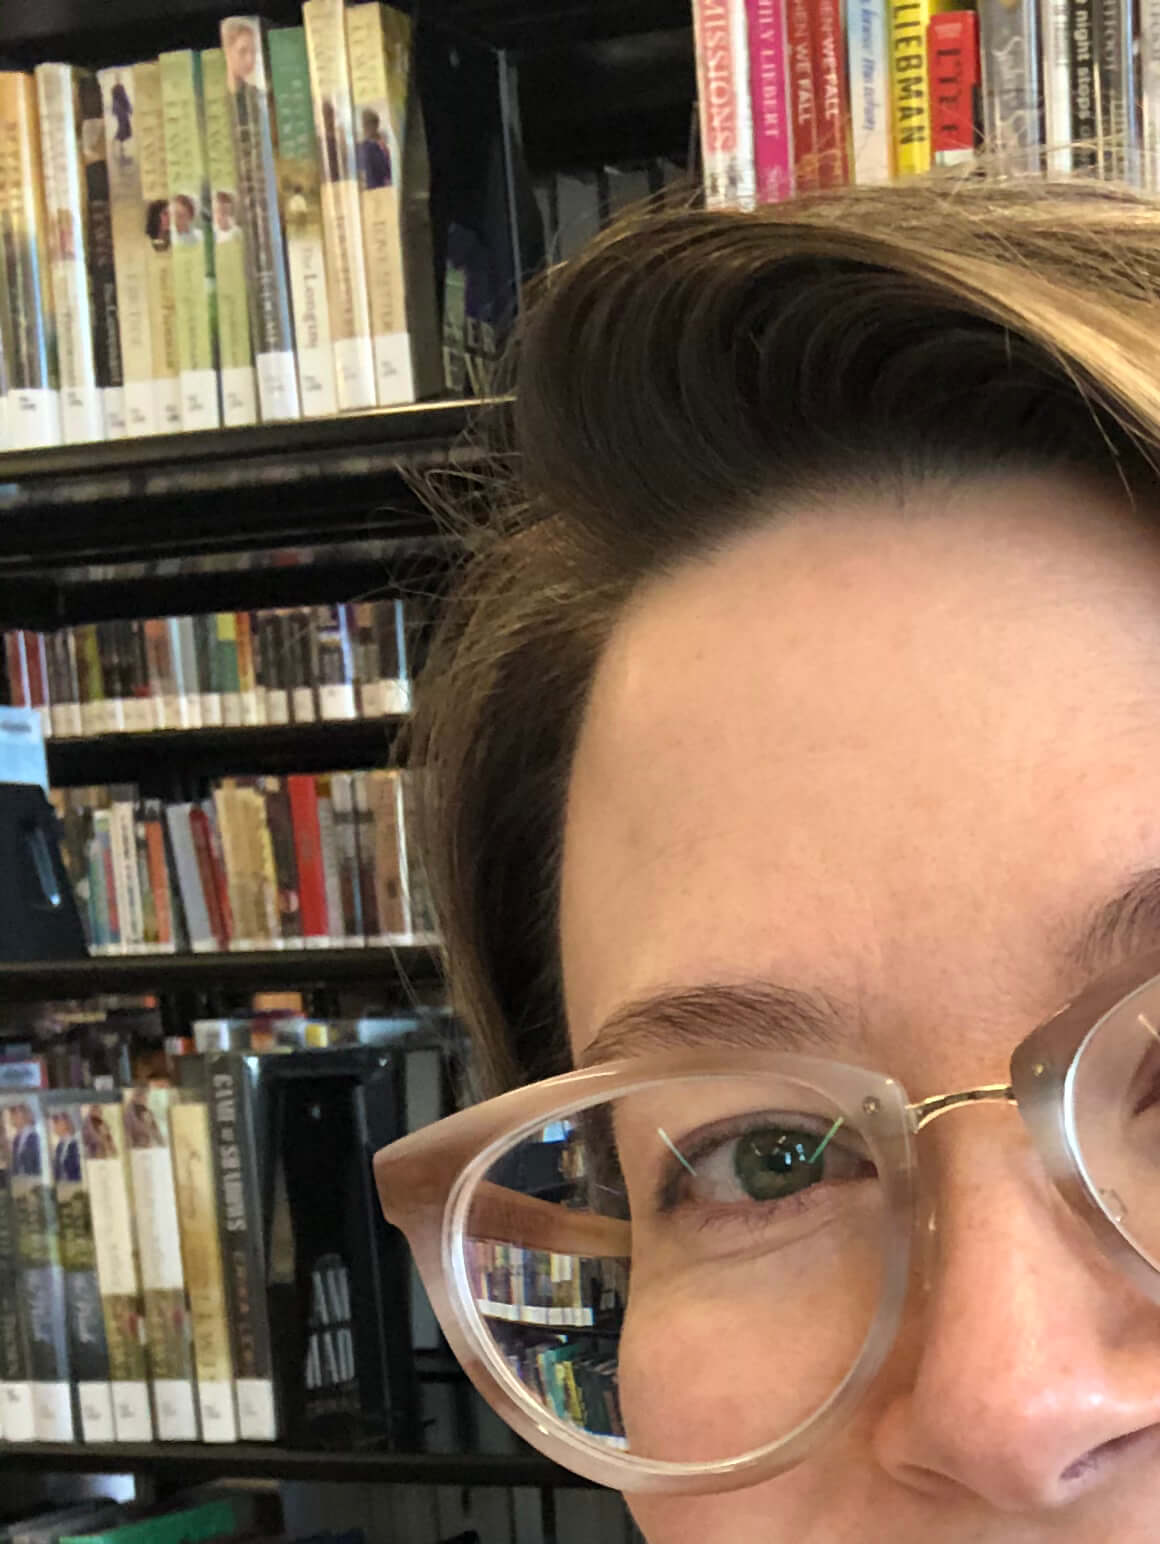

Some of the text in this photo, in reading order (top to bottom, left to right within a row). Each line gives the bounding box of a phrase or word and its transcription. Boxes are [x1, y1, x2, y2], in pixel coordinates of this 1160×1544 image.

[795, 41, 812, 73] WE
[1072, 10, 1091, 61] night
[760, 49, 780, 138] LIEBERT
[824, 72, 840, 120] FALL
[895, 3, 927, 145] LIEBMAN
[1075, 67, 1091, 120] stops
[796, 78, 813, 125] FALL
